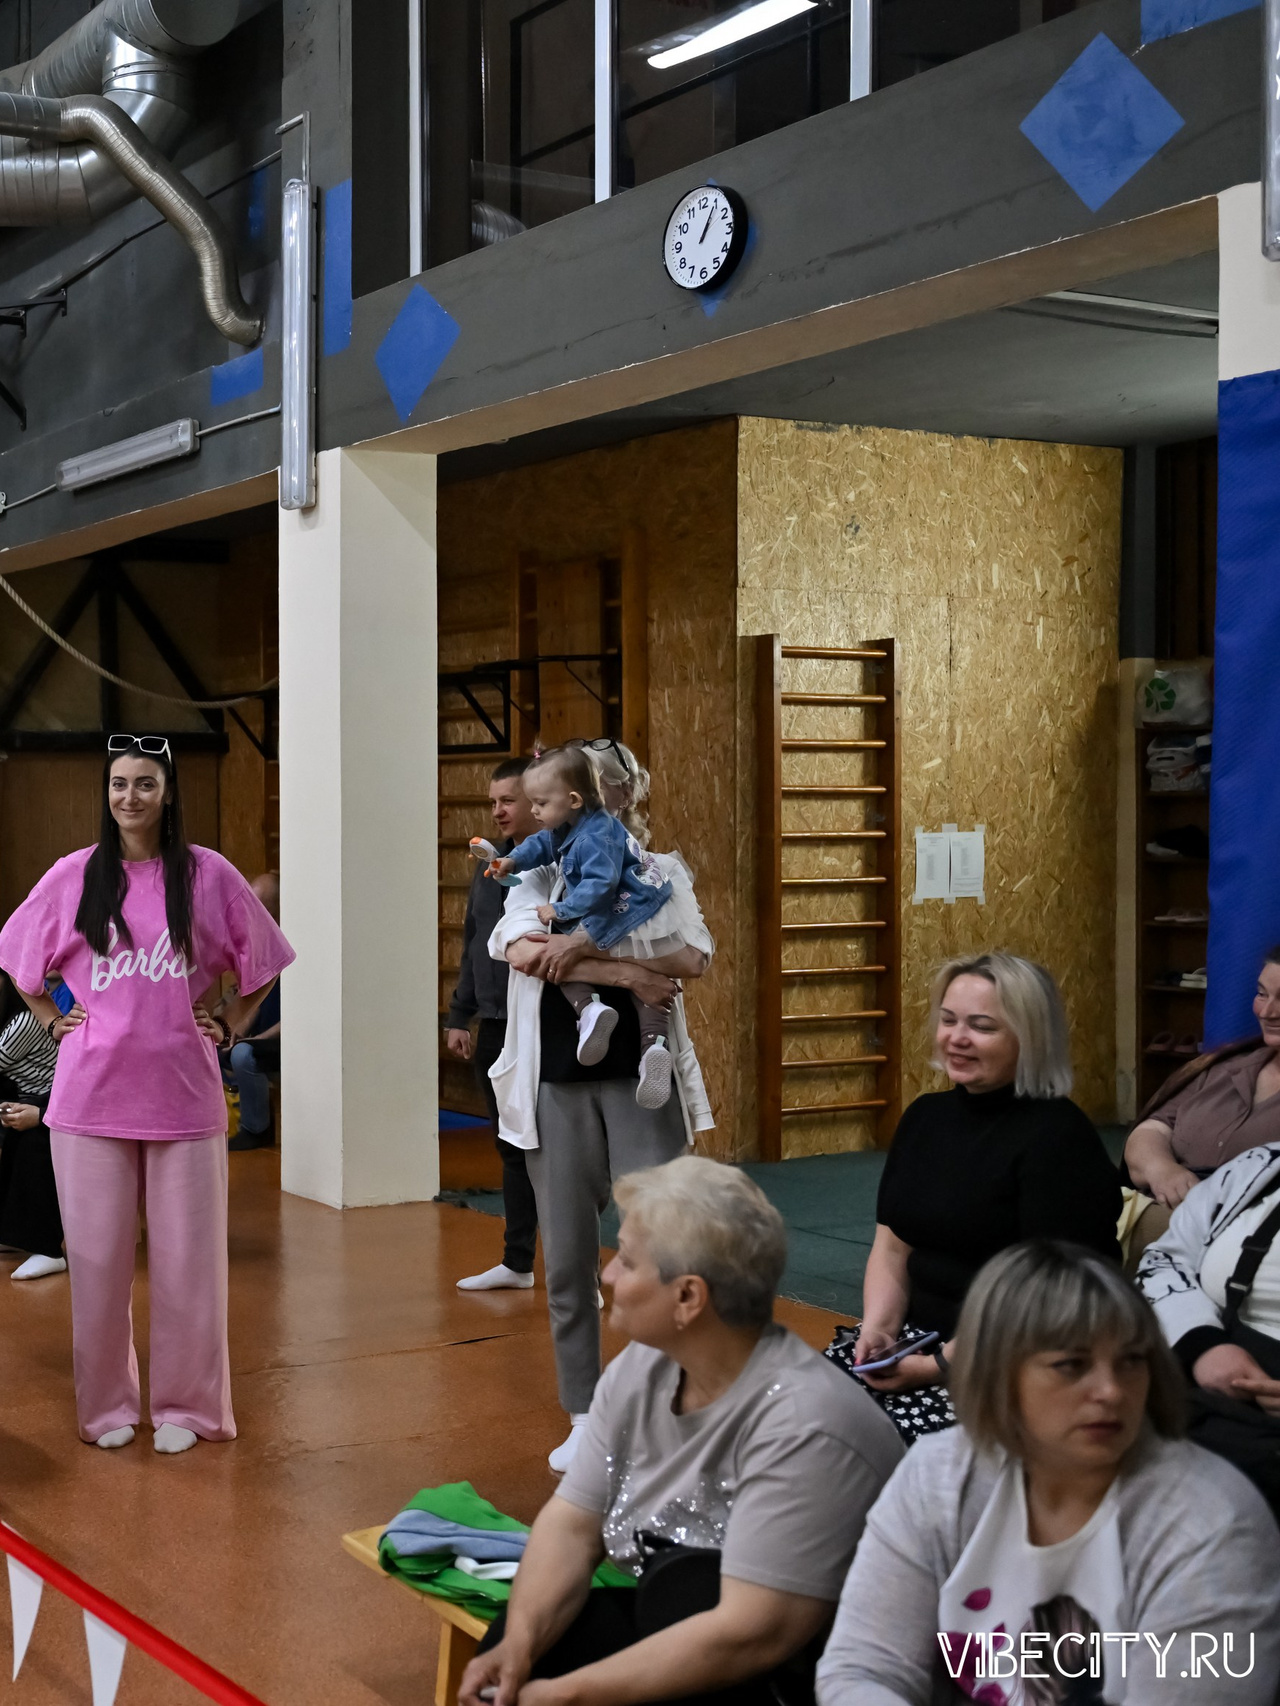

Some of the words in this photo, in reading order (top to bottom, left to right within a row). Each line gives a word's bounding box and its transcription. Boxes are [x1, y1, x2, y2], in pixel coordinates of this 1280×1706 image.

[698, 197, 708, 210] 12
[714, 198, 718, 209] 1
[687, 207, 695, 219] 11
[721, 207, 728, 220] 2
[678, 222, 689, 236] 10
[726, 222, 733, 235] 3
[675, 242, 682, 253] 9
[721, 242, 729, 253] 4
[679, 257, 686, 269] 8
[713, 257, 720, 270] 5
[689, 266, 695, 278] 7
[700, 267, 708, 279] 6
